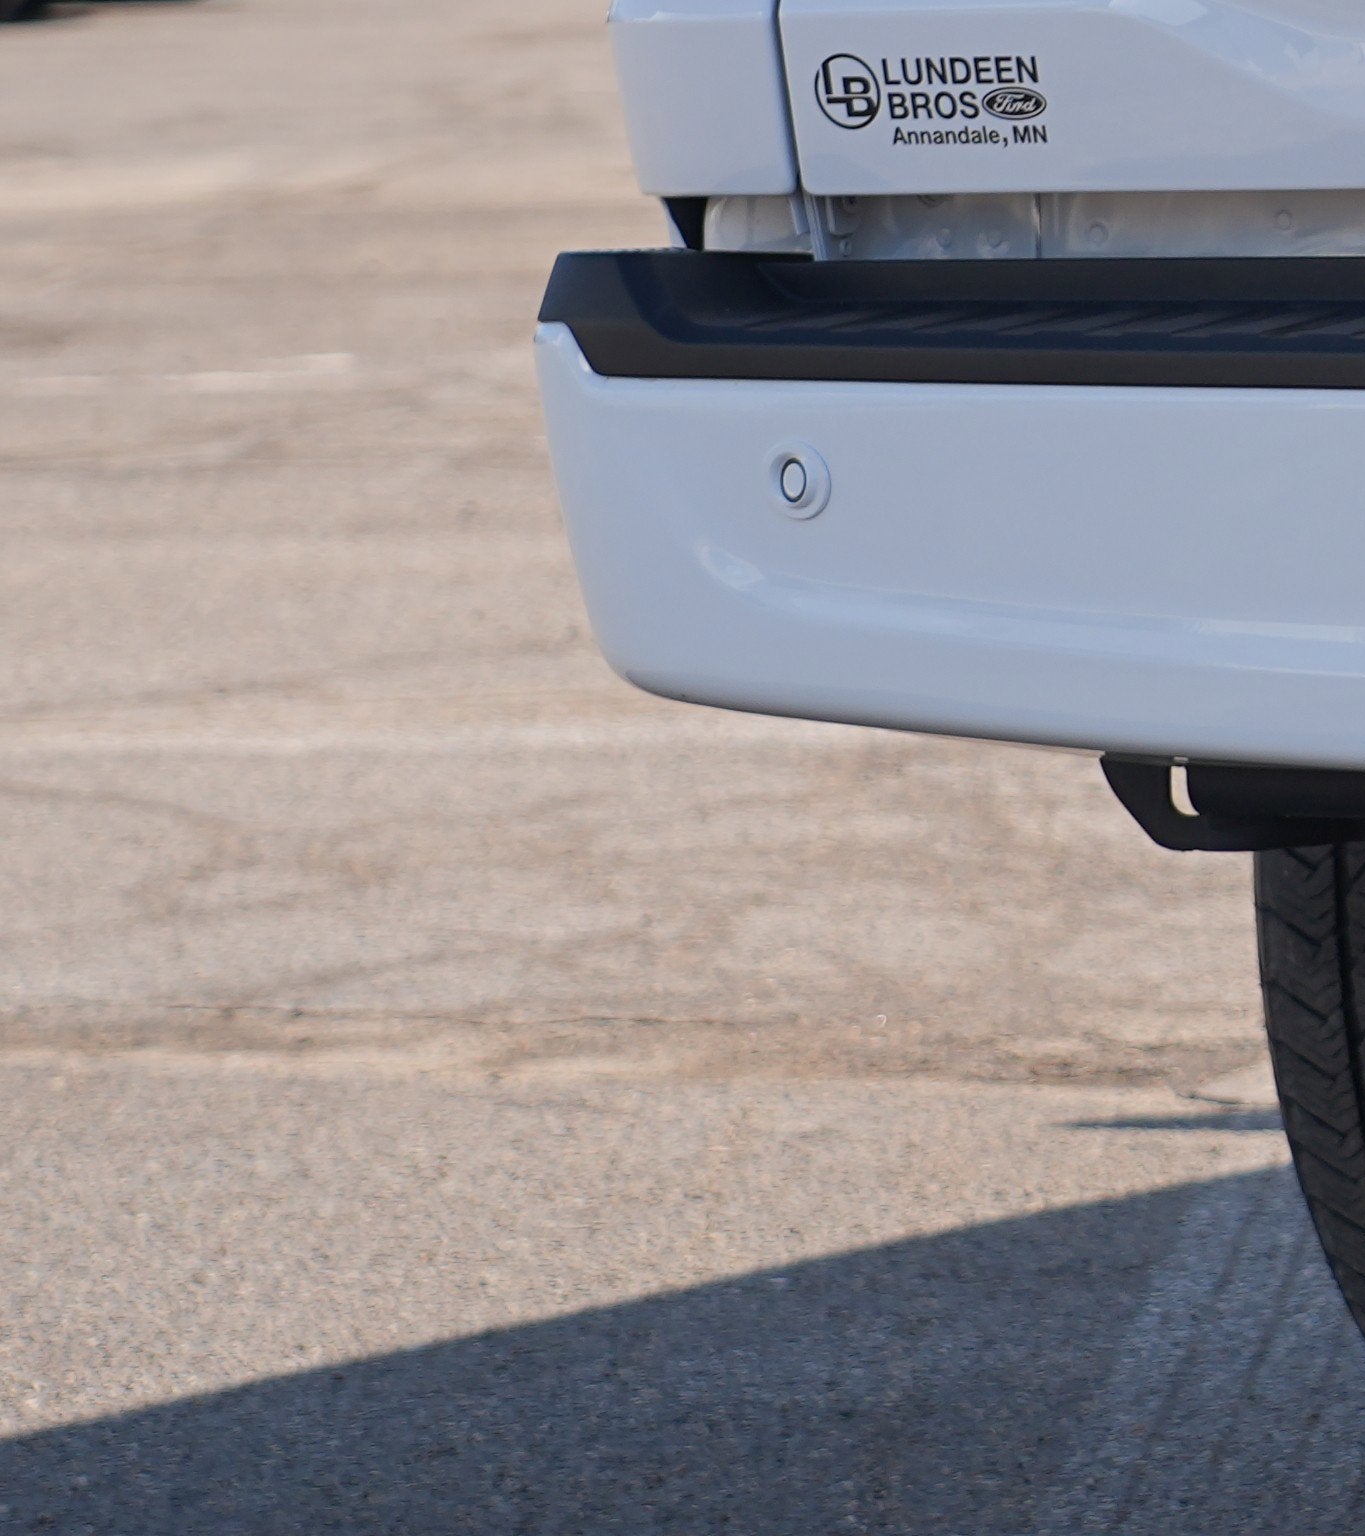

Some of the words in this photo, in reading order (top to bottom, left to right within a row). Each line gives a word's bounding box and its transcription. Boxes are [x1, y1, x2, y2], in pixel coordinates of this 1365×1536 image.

[881, 56, 1039, 85] LUNDEEN
[888, 91, 980, 119] BROS
[992, 93, 1036, 114] Ford
[893, 126, 1008, 147] Annandale,
[1012, 125, 1048, 143] MN
